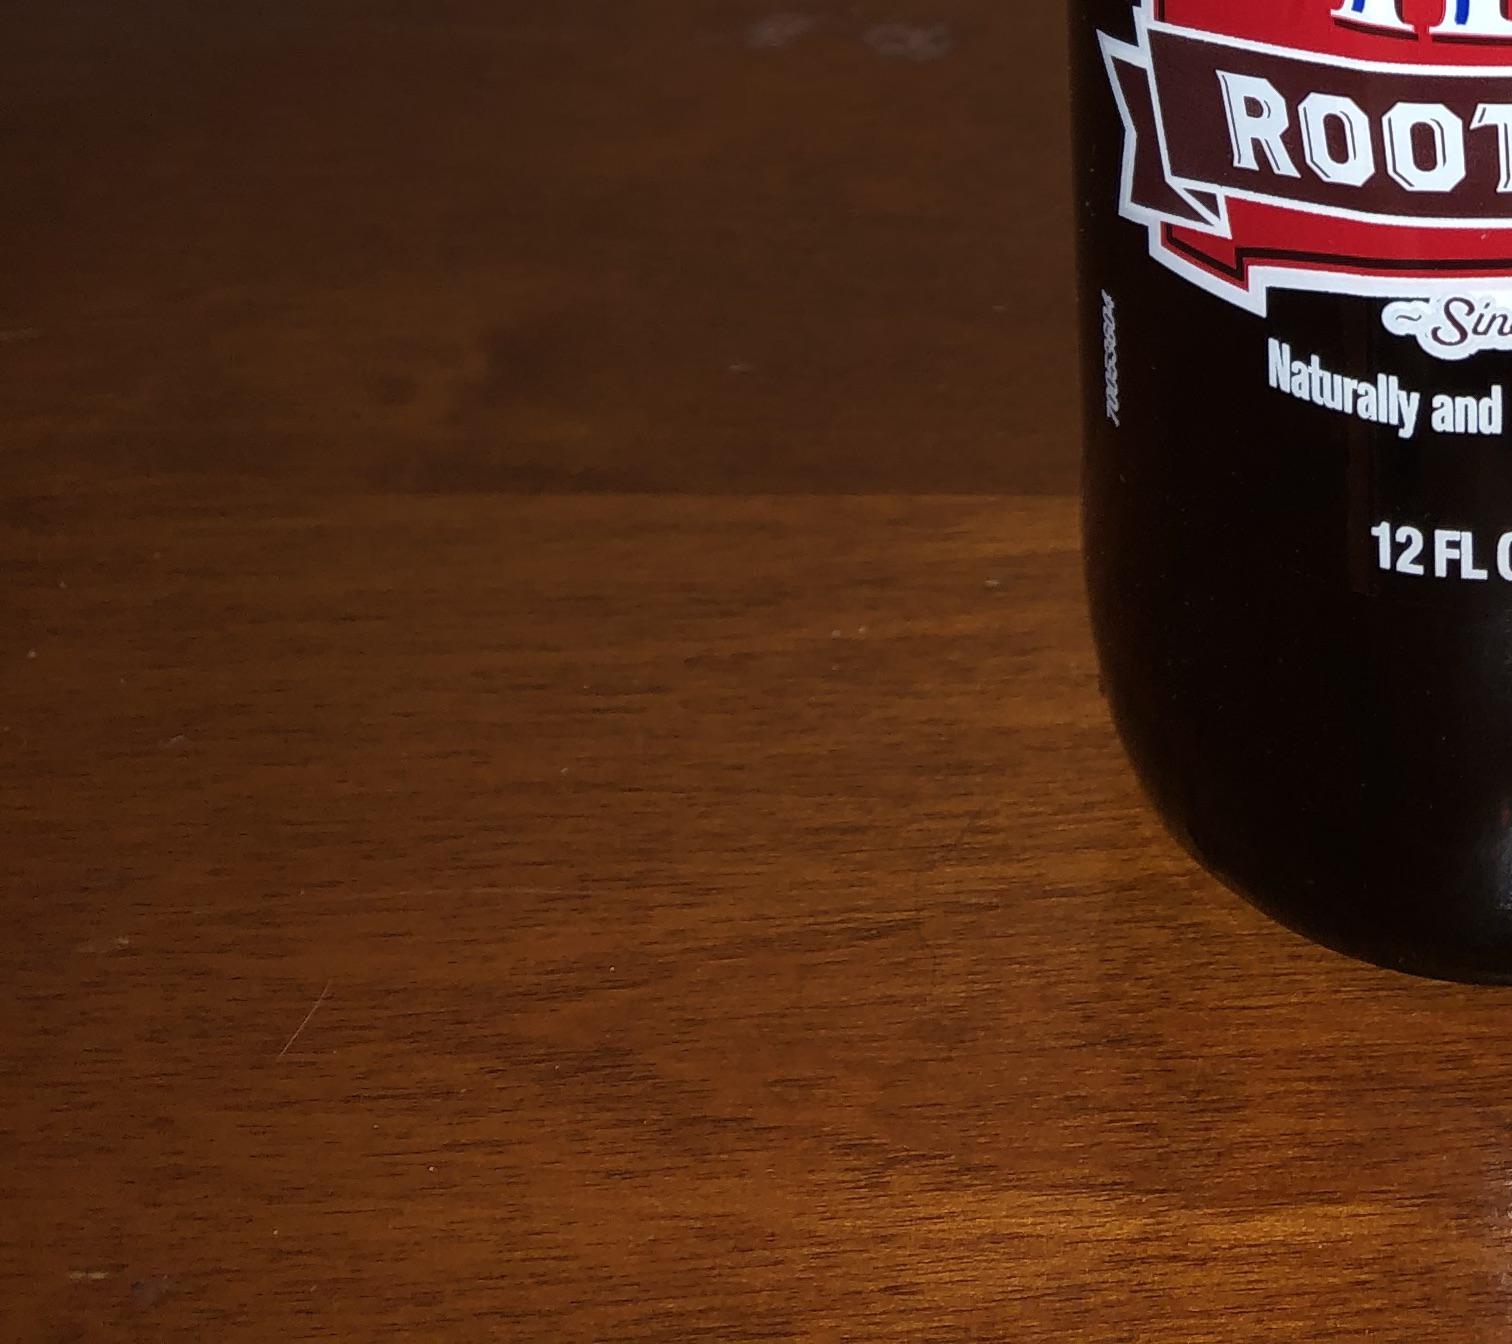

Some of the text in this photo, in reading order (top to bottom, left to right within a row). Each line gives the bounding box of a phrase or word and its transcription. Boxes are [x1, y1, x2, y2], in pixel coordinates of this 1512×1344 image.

[1267, 337, 1420, 439] Naturally
[1431, 384, 1503, 435] and
[1370, 521, 1425, 576] 12
[1434, 528, 1488, 581] FL
